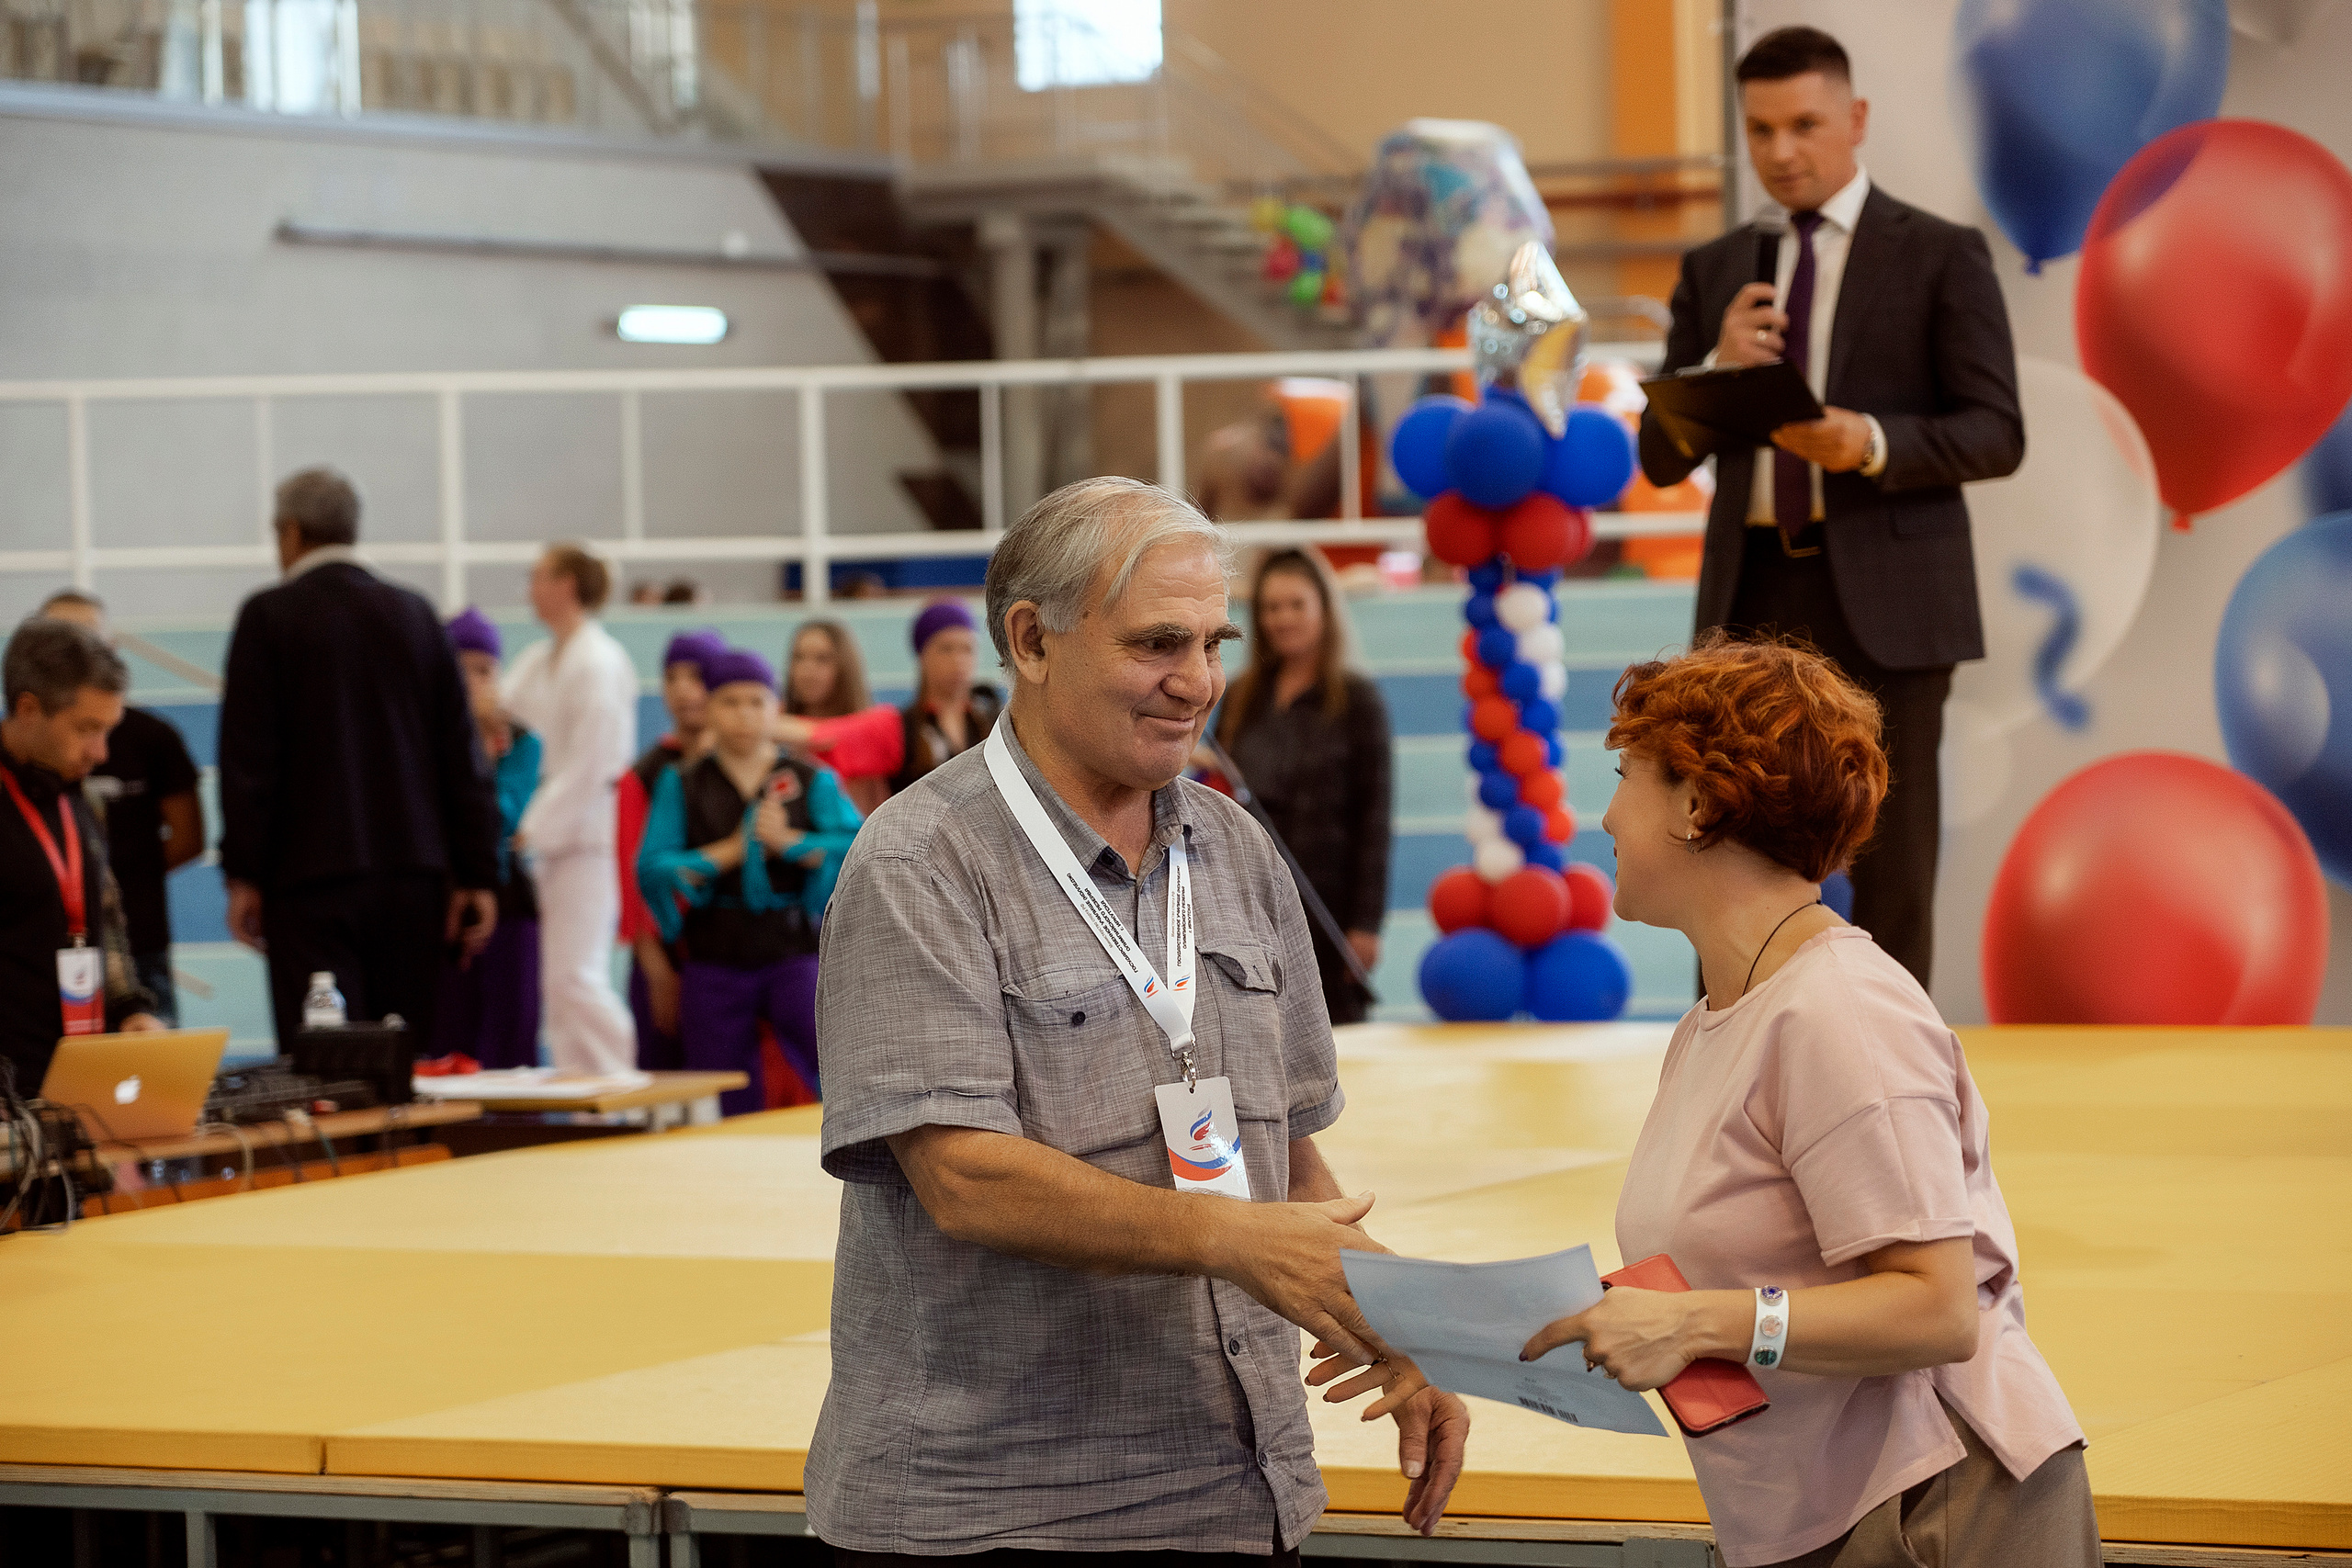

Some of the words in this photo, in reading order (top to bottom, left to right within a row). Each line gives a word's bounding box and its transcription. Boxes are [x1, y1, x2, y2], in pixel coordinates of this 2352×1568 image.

[1083, 887, 1102, 911] РЕЗЕРВА
[1100, 899, 1121, 928] ИРКУТСКА
[1092, 921, 1114, 948] Министерство
[1100, 910, 1131, 952] ОЛИМПИЙСКОГО
[1102, 924, 1138, 974] ГОСУДАРСТВЕННОЕ
